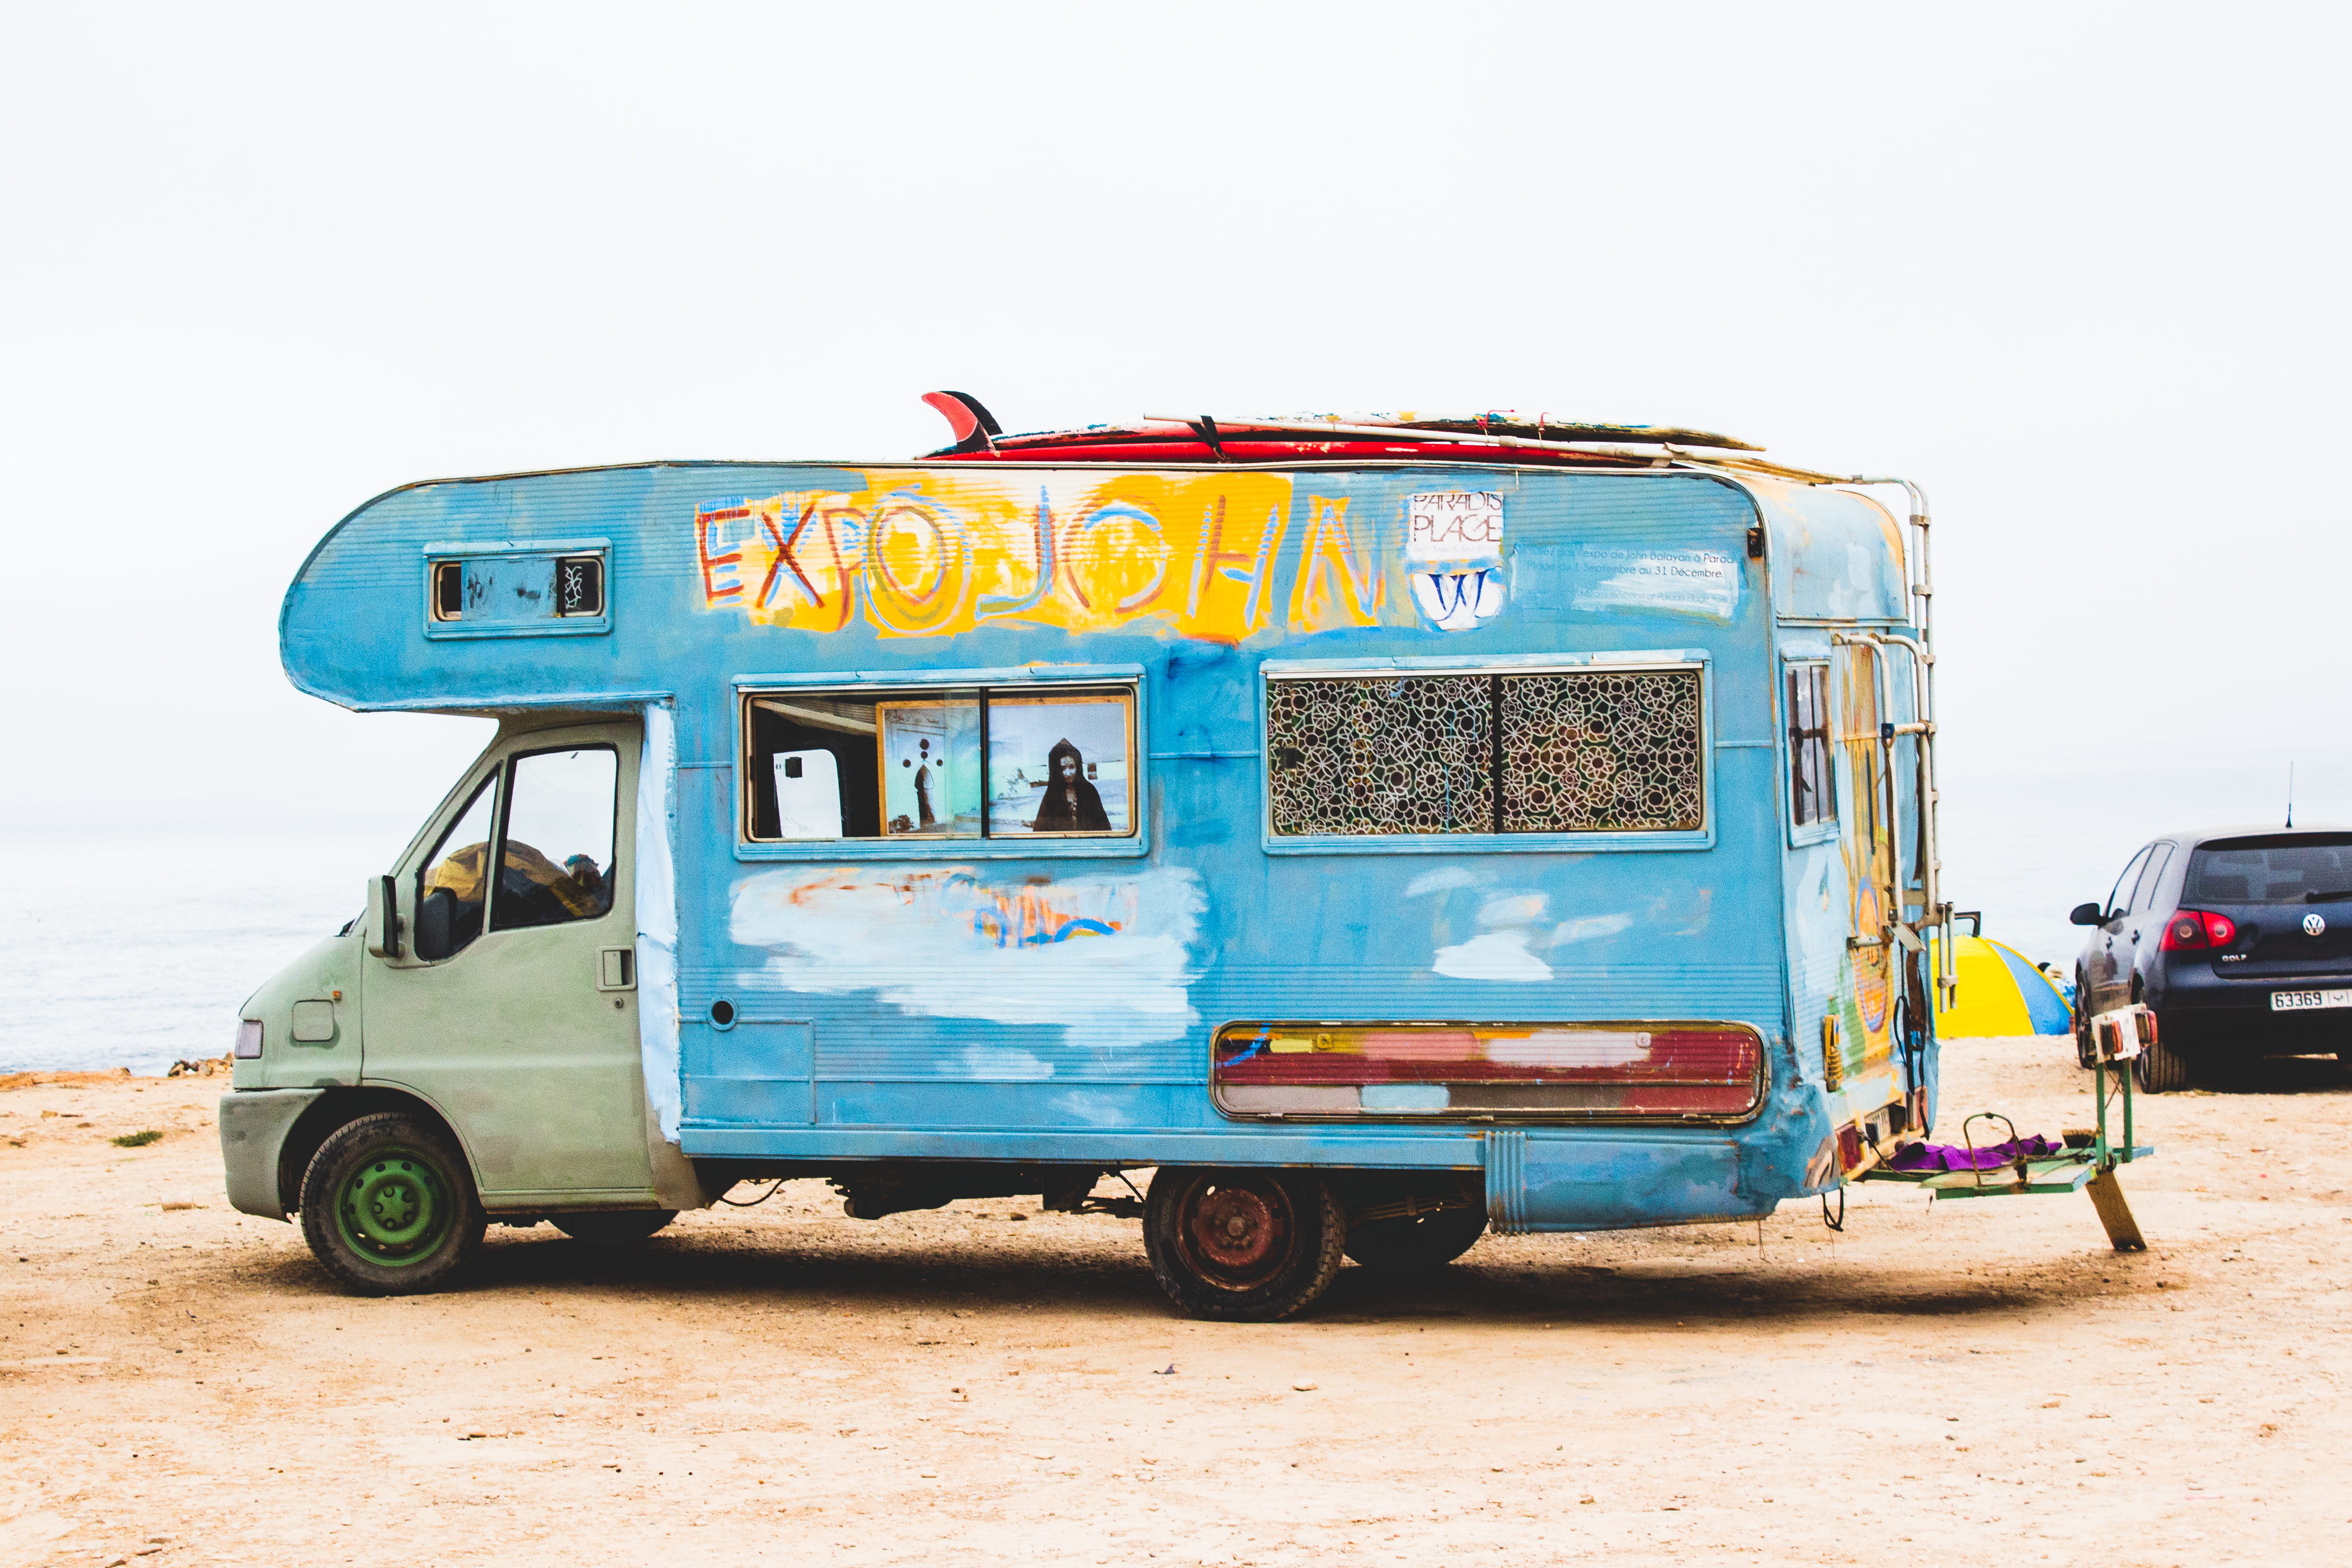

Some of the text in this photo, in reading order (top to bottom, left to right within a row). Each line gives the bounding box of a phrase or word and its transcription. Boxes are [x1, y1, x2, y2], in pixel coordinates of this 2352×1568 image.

[1413, 491, 1502, 511] PARADIS
[1413, 514, 1502, 542] PLAGE
[696, 484, 1385, 633] EXPO JOHN
[1610, 548, 1624, 558] de
[1649, 550, 1691, 563] Balayan
[1655, 566, 1667, 576] 31
[2275, 992, 2322, 1007] 63369
